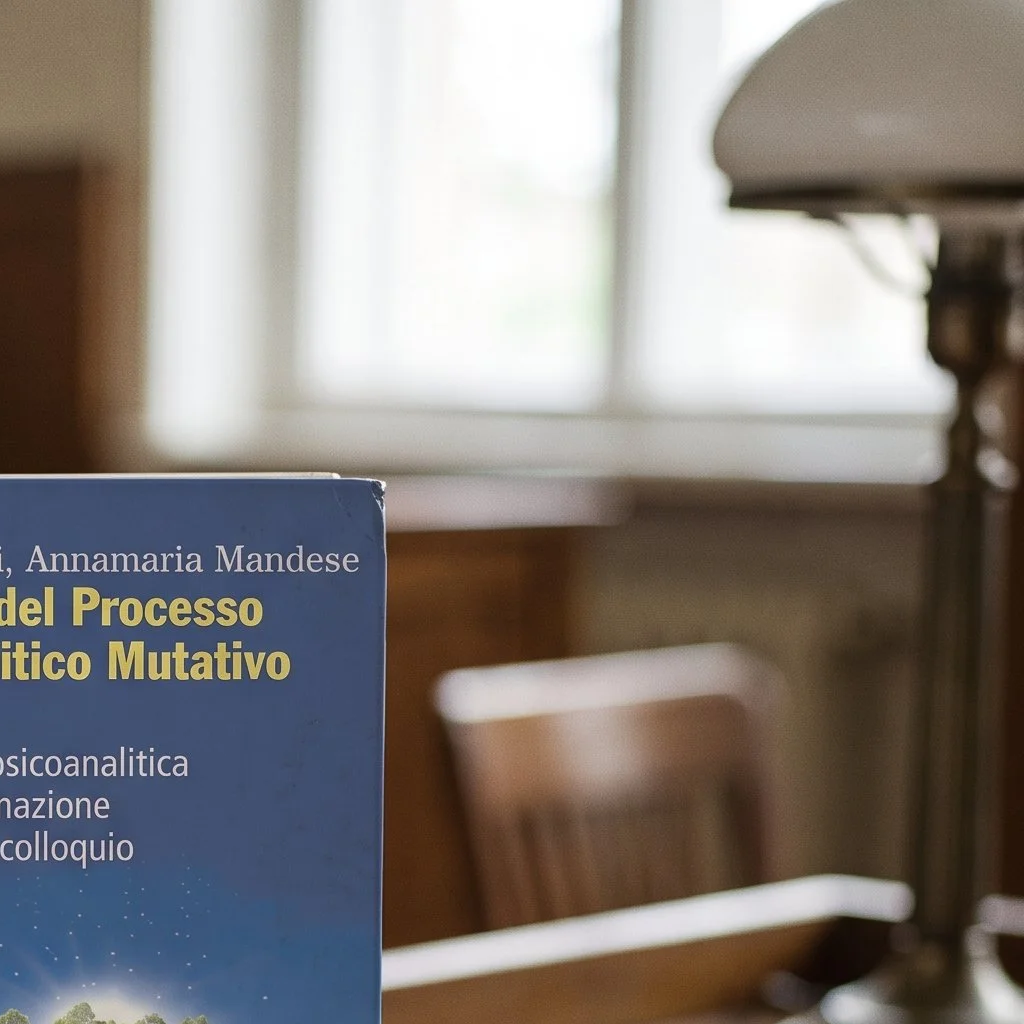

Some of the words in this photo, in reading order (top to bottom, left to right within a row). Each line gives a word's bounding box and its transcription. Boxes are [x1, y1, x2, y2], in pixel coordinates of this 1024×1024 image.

[25, 545, 203, 573] Annamaria
[215, 545, 360, 573] Mandese
[72, 586, 264, 627] Processo
[108, 640, 291, 681] Mutativo
[0, 830, 134, 869] colloquio
